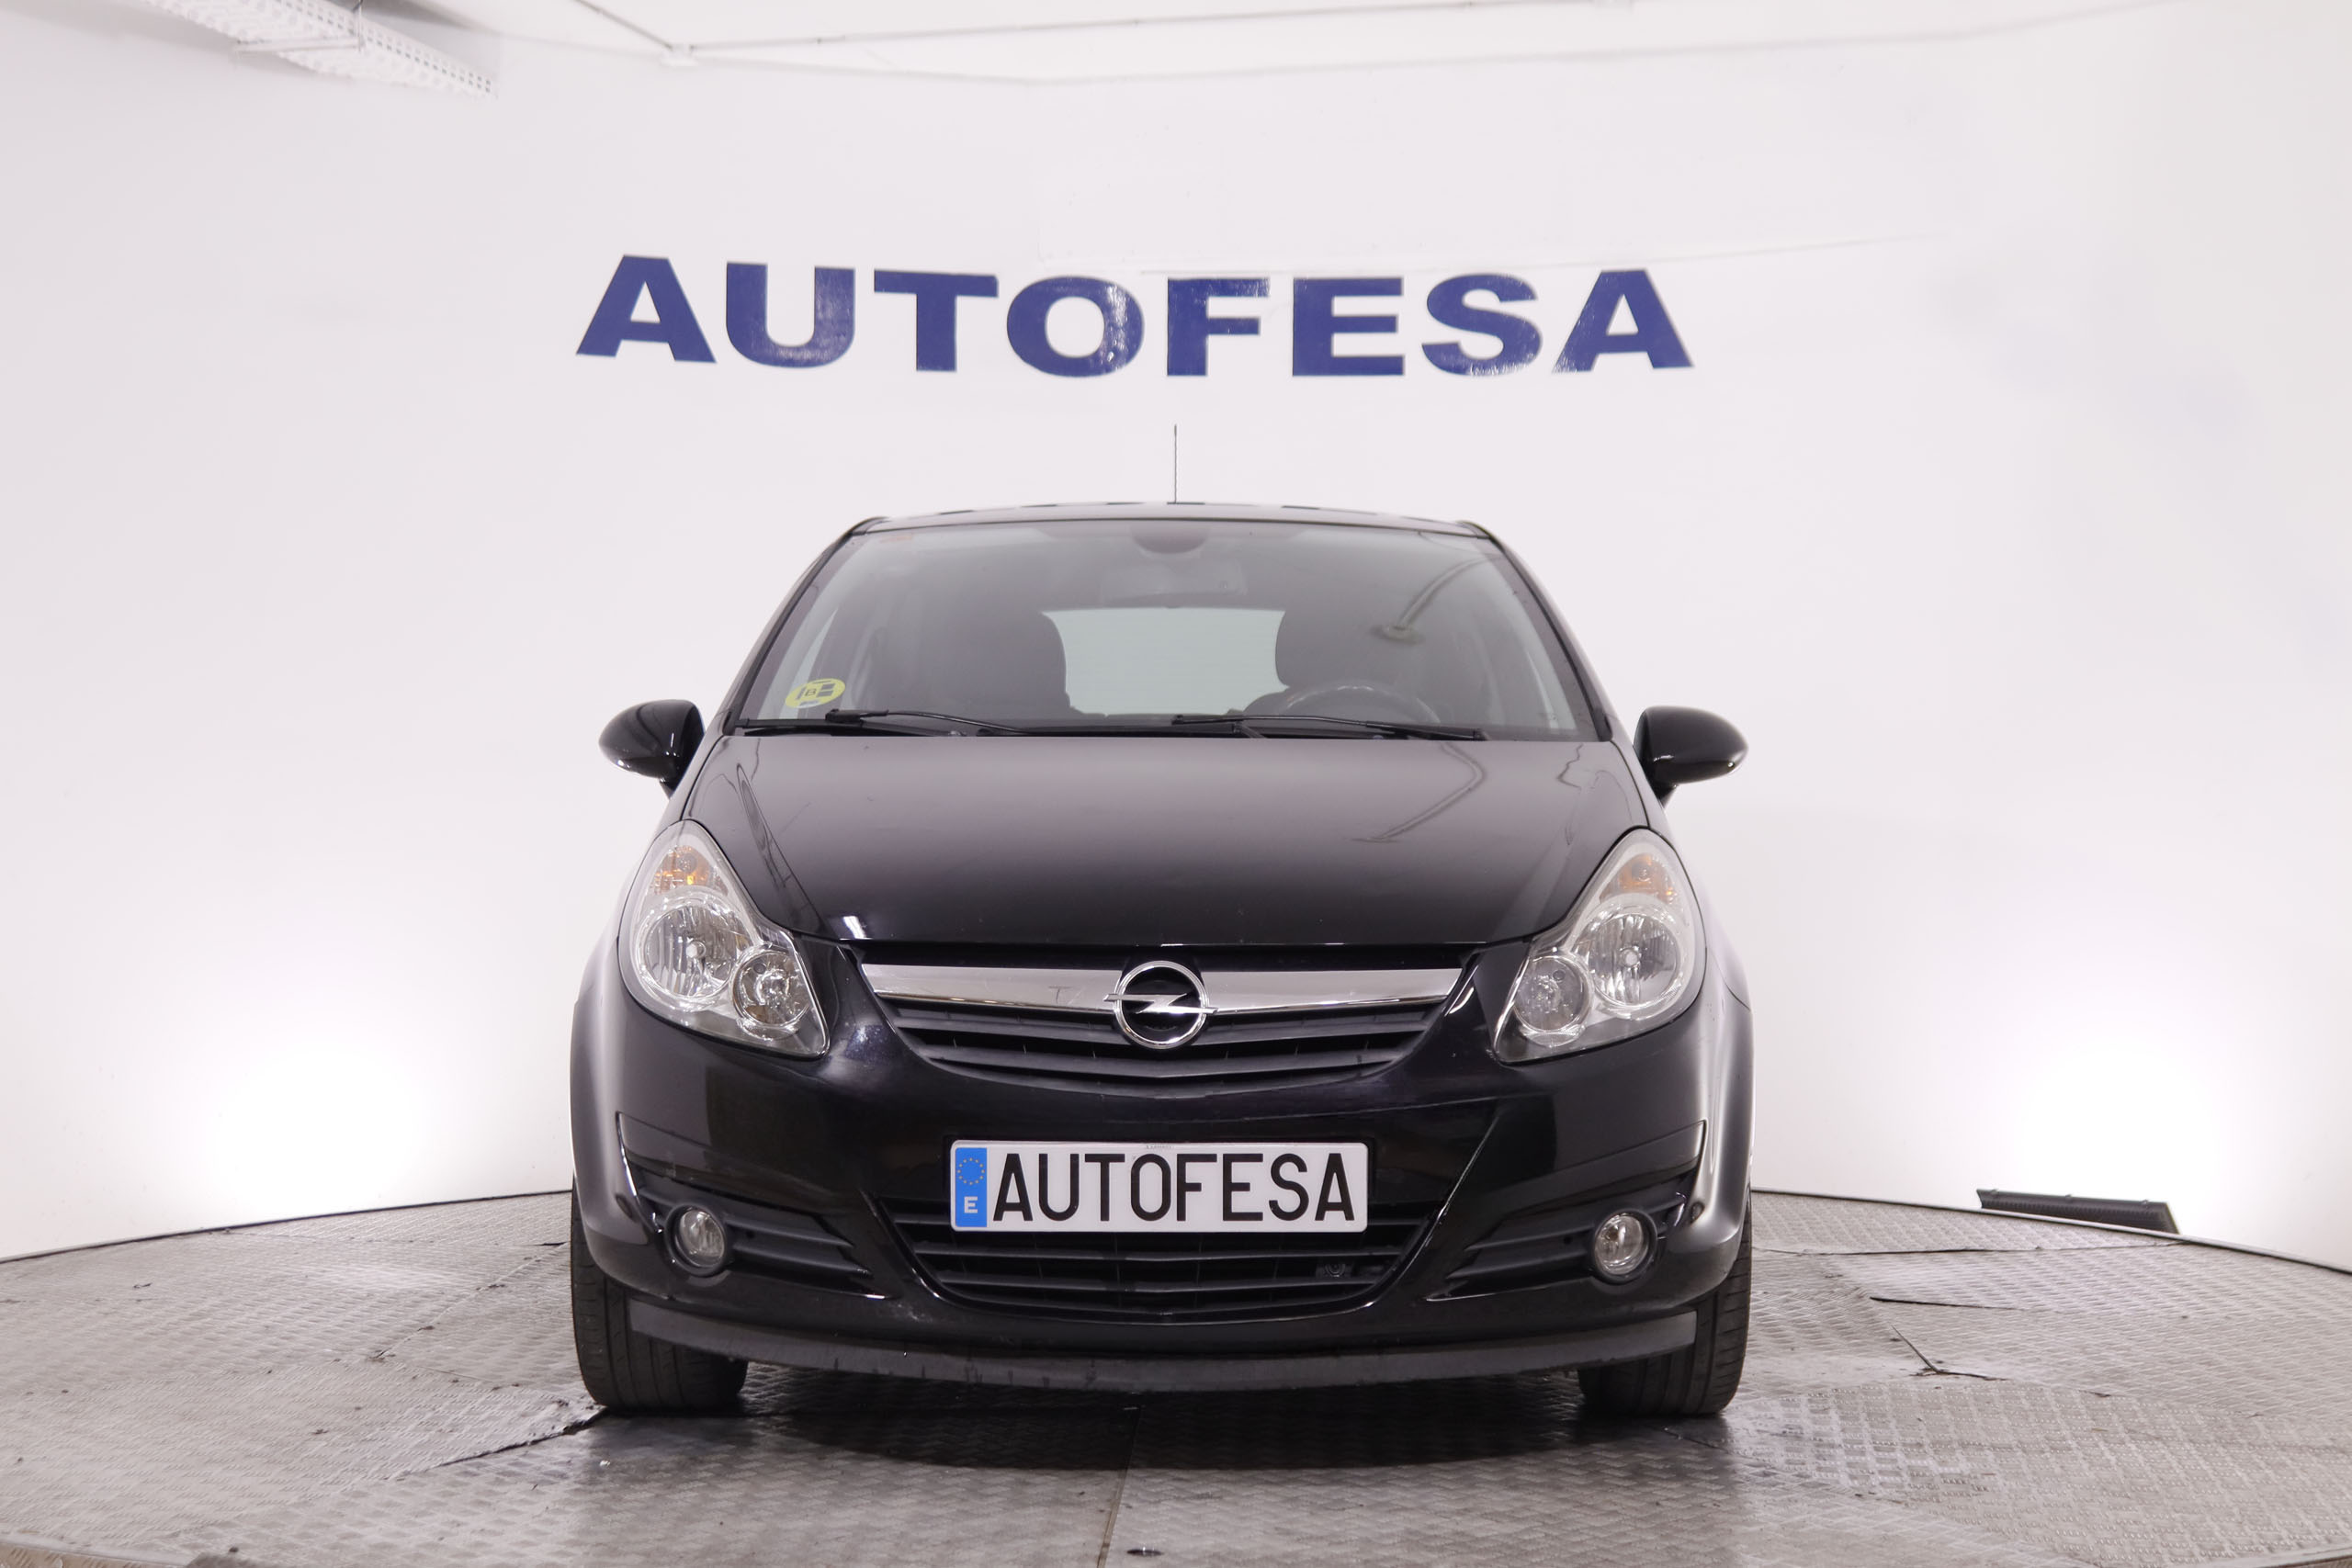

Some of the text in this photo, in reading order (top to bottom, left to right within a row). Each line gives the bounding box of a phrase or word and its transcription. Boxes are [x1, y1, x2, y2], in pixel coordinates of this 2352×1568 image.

[576, 254, 1694, 378] AUTOFESA
[964, 1196, 978, 1213] E
[993, 1153, 1355, 1222] AUTOFESA
